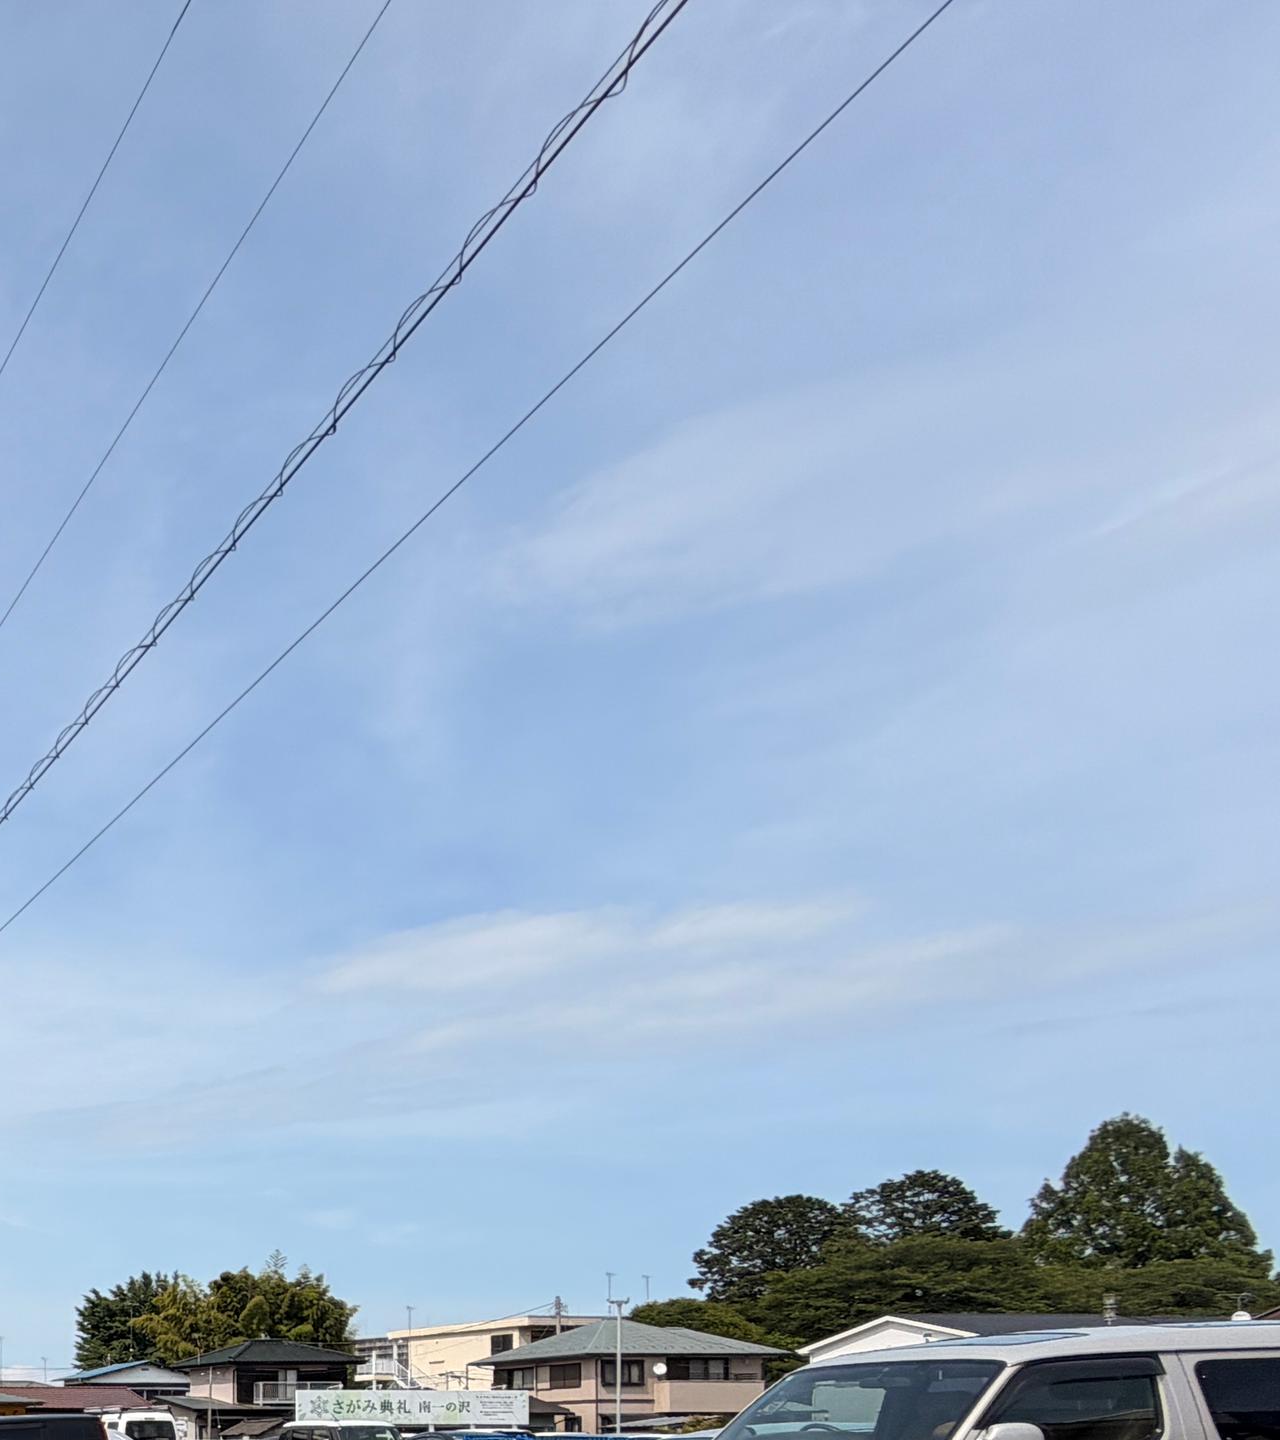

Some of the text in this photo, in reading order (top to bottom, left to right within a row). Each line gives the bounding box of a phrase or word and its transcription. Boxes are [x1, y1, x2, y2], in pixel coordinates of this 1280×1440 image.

[331, 1399, 412, 1415] さがみ典礼
[418, 1400, 471, 1414] 南一の沢
